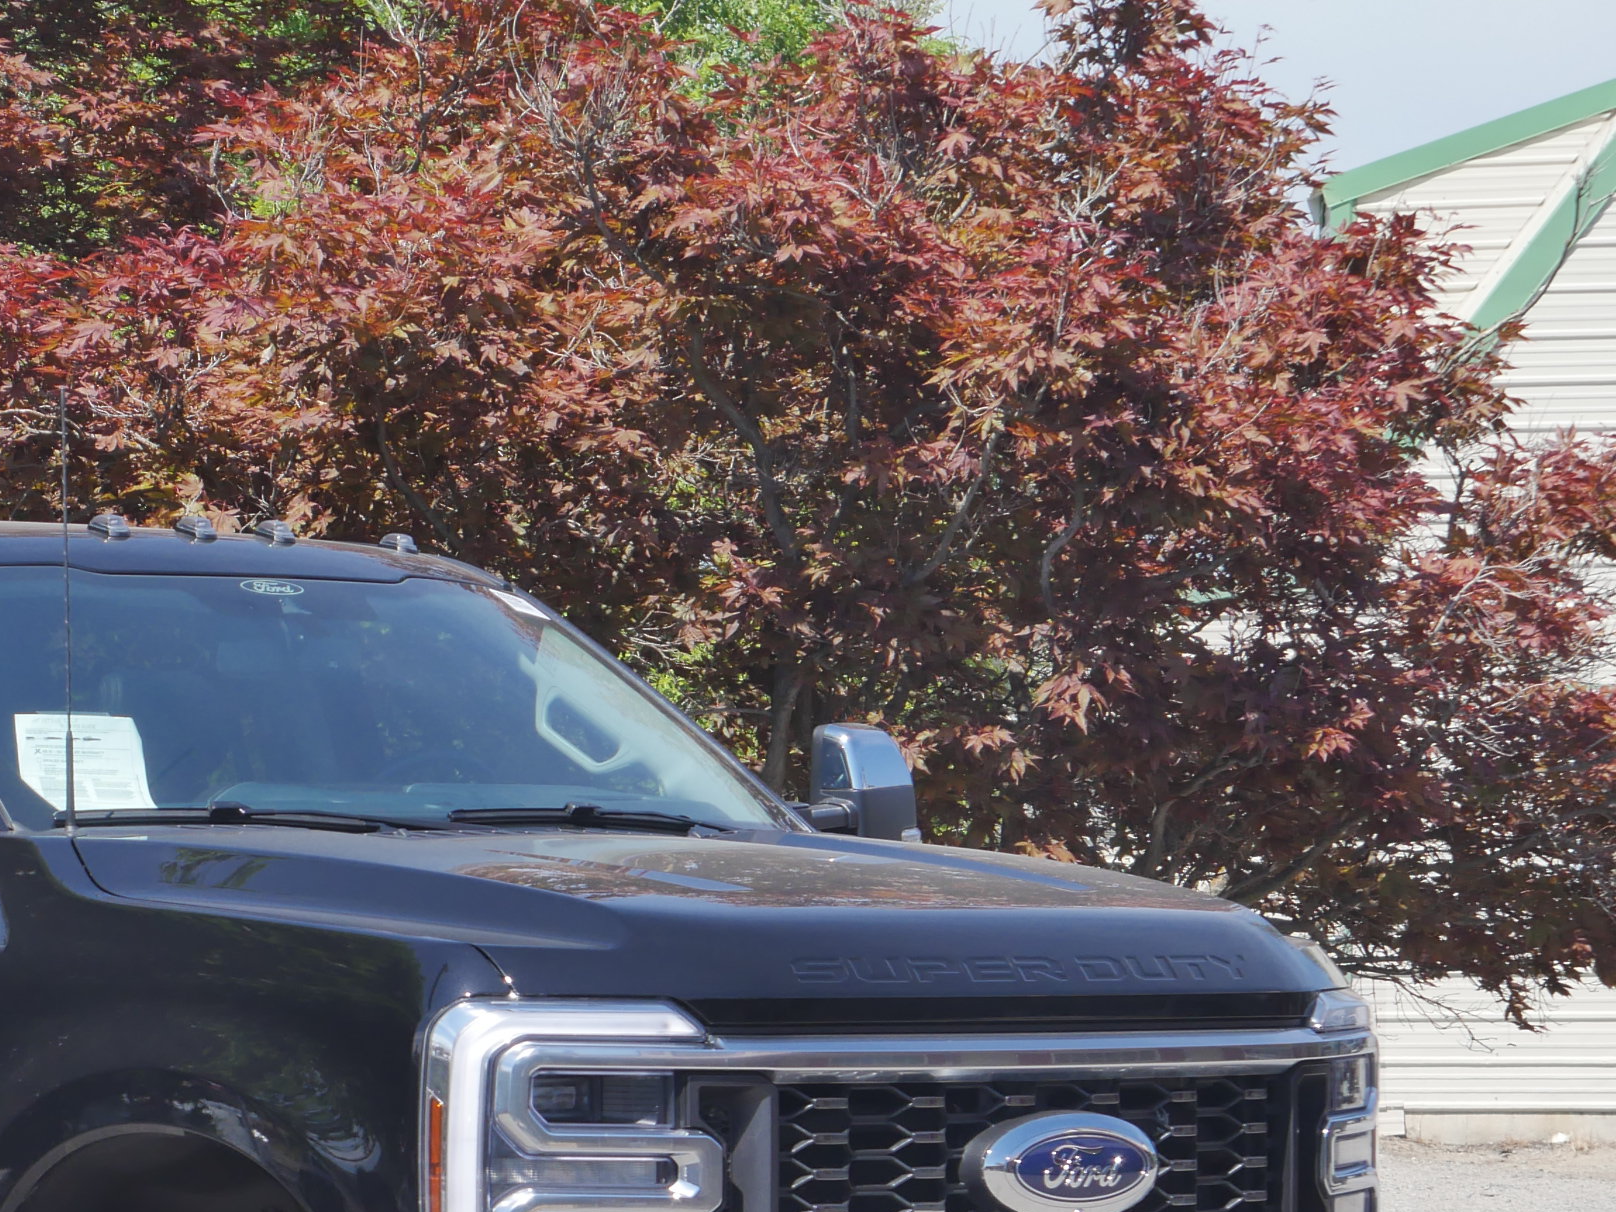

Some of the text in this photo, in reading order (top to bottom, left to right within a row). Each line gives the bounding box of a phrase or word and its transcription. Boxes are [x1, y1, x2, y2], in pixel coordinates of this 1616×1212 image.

[252, 581, 295, 593] Ford
[789, 952, 1246, 984] SUPER DUTY
[1044, 1144, 1123, 1189] Ford
